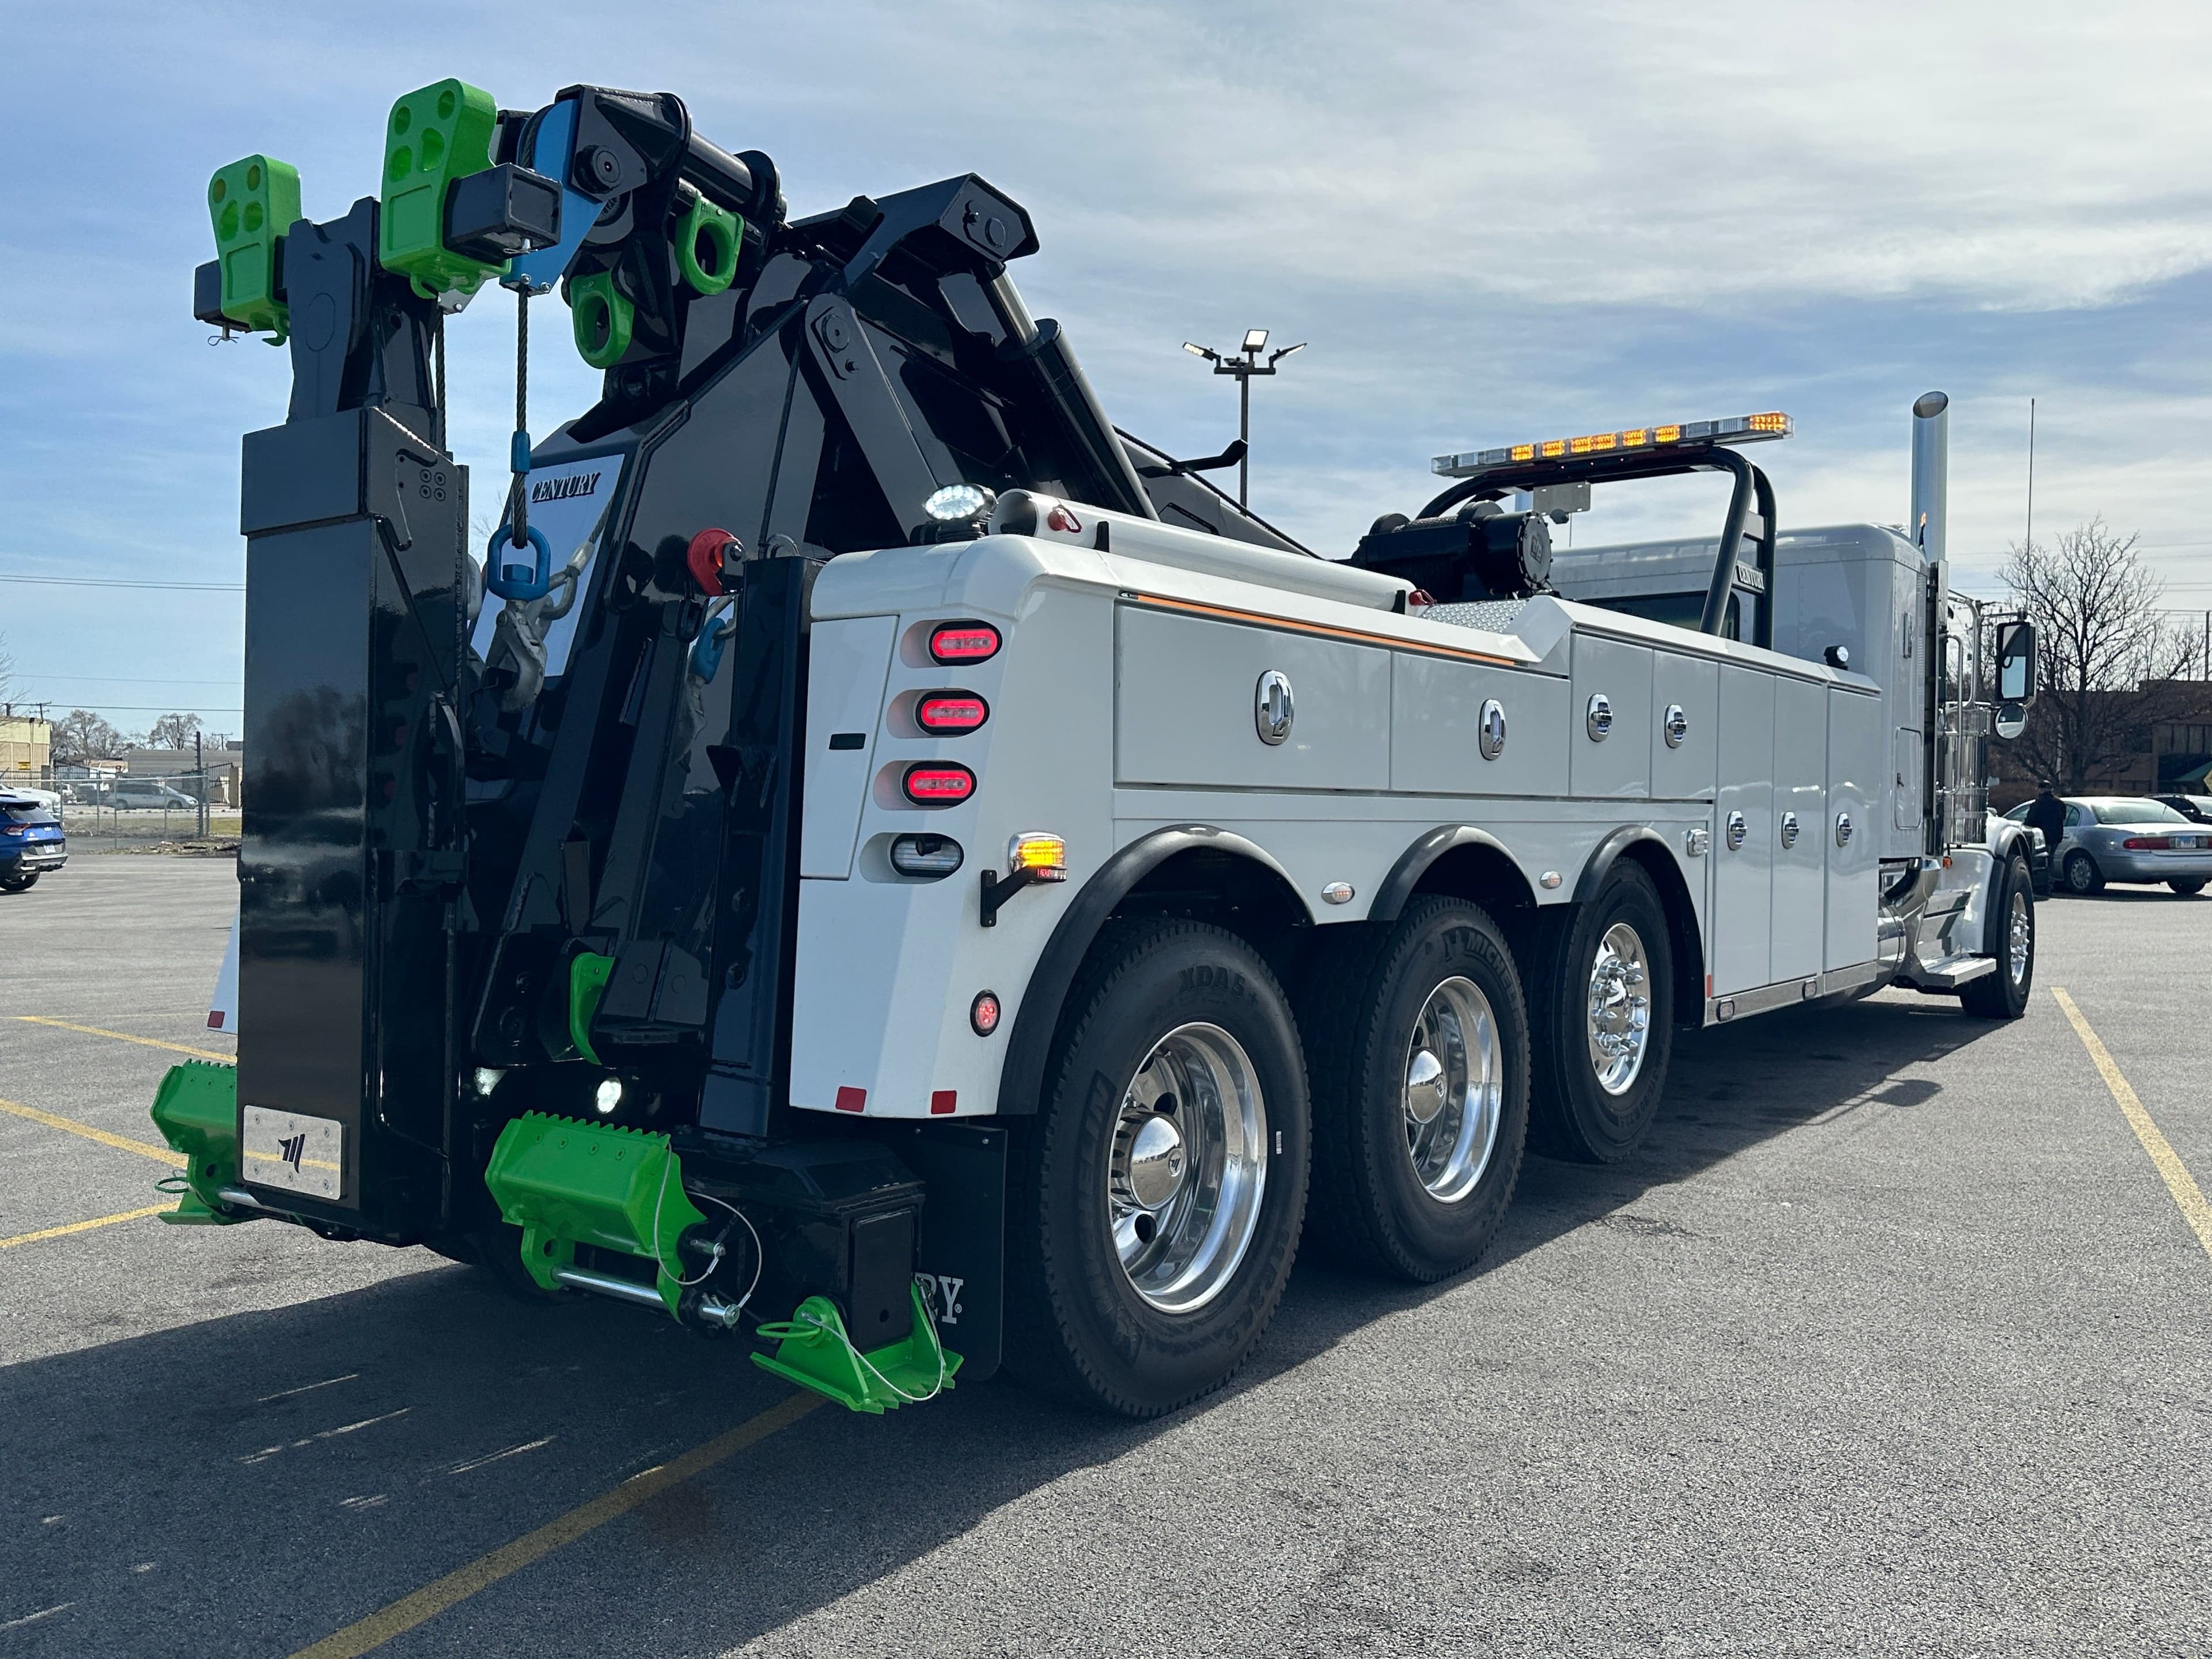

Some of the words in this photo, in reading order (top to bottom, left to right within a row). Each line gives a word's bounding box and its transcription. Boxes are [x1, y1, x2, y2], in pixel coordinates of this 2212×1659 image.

[531, 472, 601, 503] CENTURY
[1738, 566, 1764, 590] CENTURY
[1467, 930, 1521, 1033] MICHELIN
